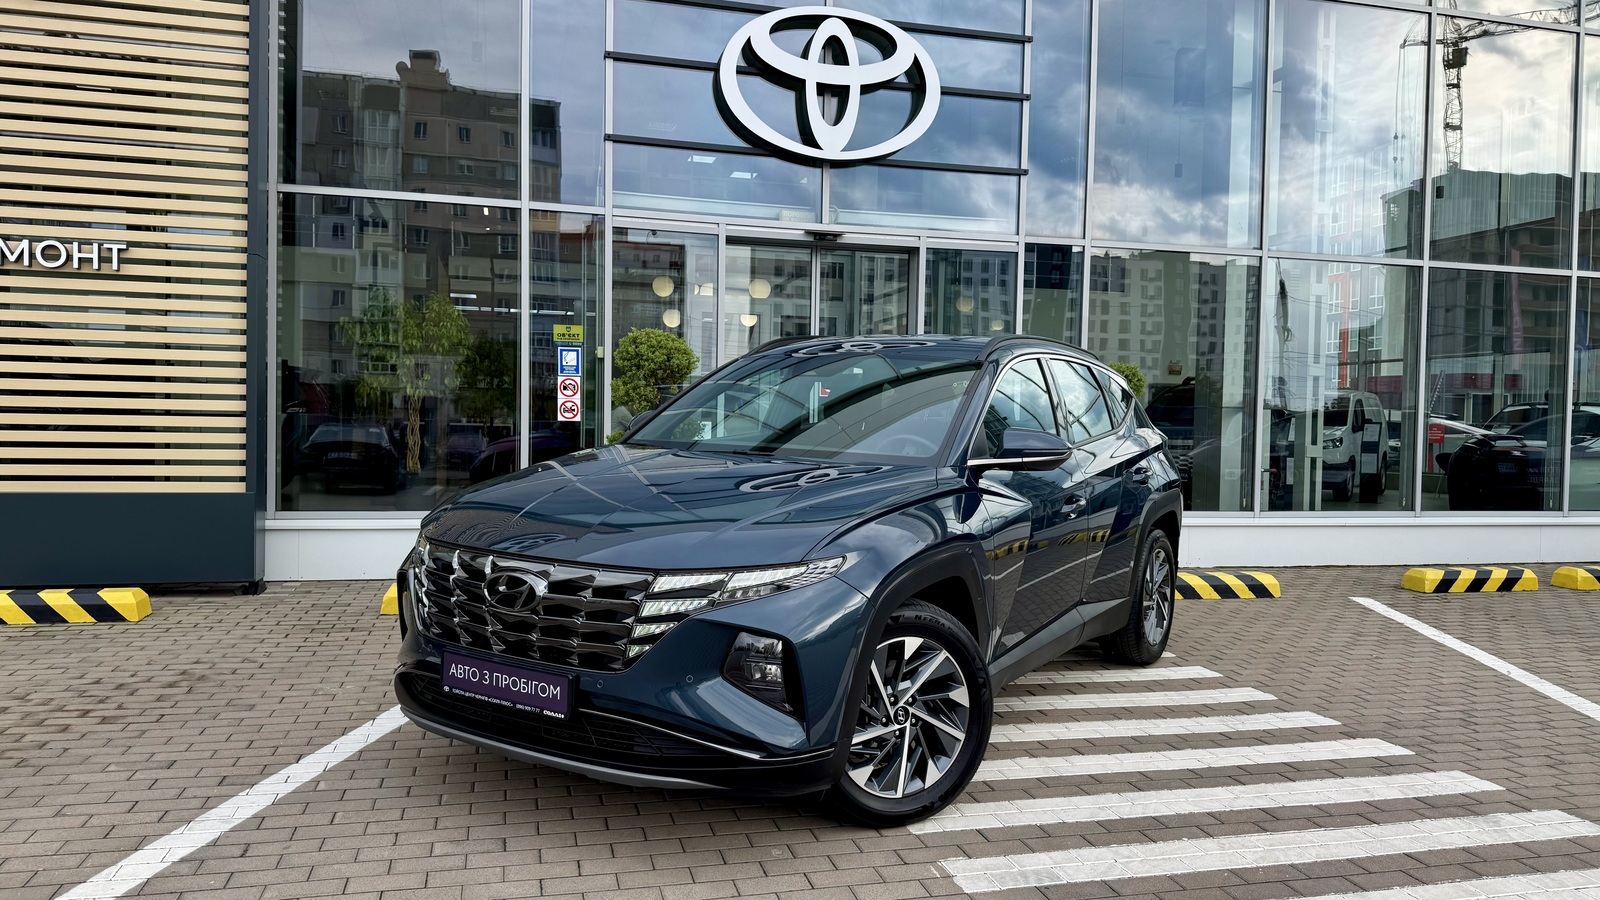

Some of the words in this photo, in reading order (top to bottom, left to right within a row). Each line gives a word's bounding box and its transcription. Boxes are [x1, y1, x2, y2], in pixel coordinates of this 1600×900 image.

[0, 238, 127, 270] МОНТ
[449, 663, 480, 682] АВТО
[482, 670, 490, 684] З
[493, 672, 561, 700] ПРОБІГОМ
